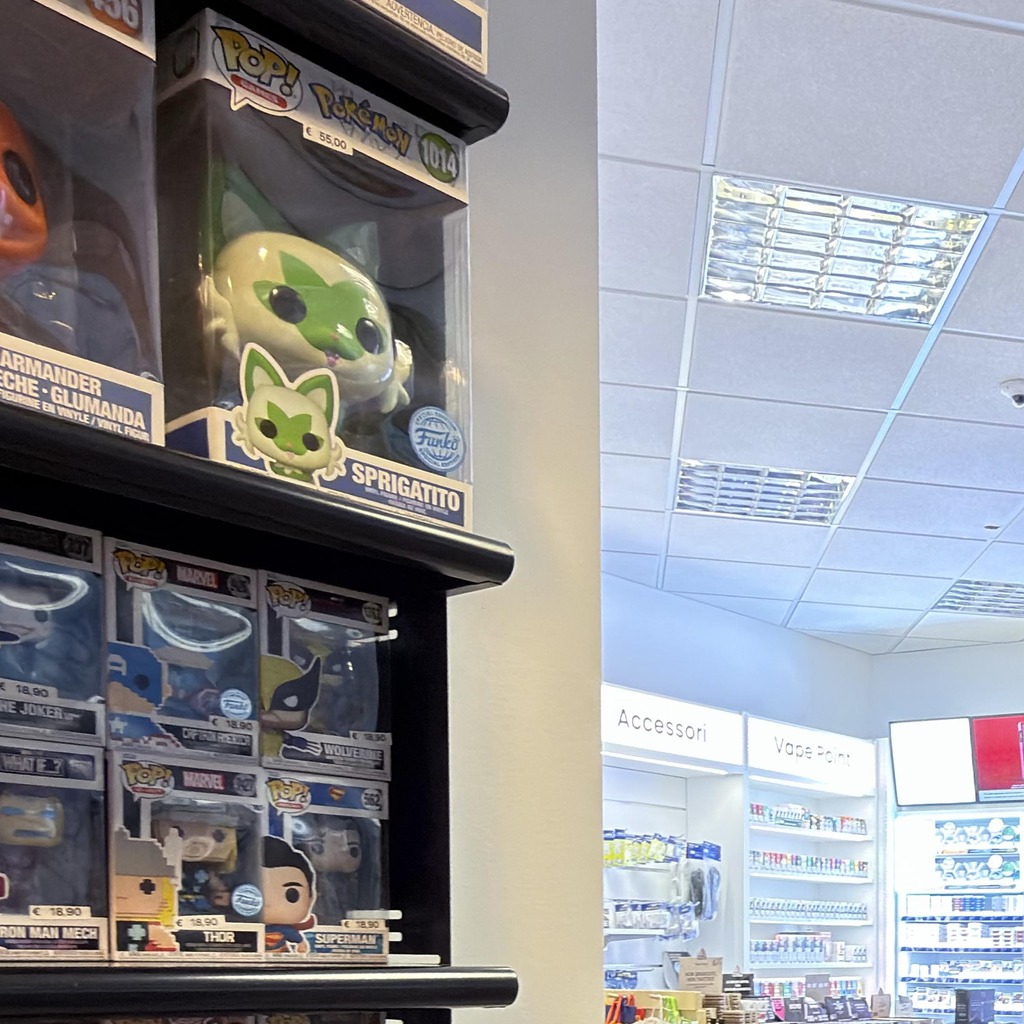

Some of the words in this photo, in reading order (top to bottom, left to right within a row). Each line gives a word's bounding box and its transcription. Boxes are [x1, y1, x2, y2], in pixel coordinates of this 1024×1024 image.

[211, 26, 301, 97] POP!
[306, 126, 313, 137] €
[319, 131, 347, 150] 55,00
[422, 141, 457, 179] 1014
[51, 385, 146, 431] GLUMANDA
[57, 406, 90, 425] VINYLE
[414, 427, 459, 451] Funko
[351, 462, 460, 512] SPRIGATITO
[111, 546, 166, 580] POP!
[617, 708, 707, 743] Accessori
[323, 743, 383, 762] WOLVERINE
[774, 735, 818, 764] Vape
[119, 761, 173, 787] POP!
[182, 770, 225, 790] MARVEL
[266, 779, 310, 802] POP!
[29, 926, 60, 939] MAN
[62, 927, 98, 939] MECH
[202, 931, 236, 943] THOR
[315, 933, 377, 945] SUPERMAN
